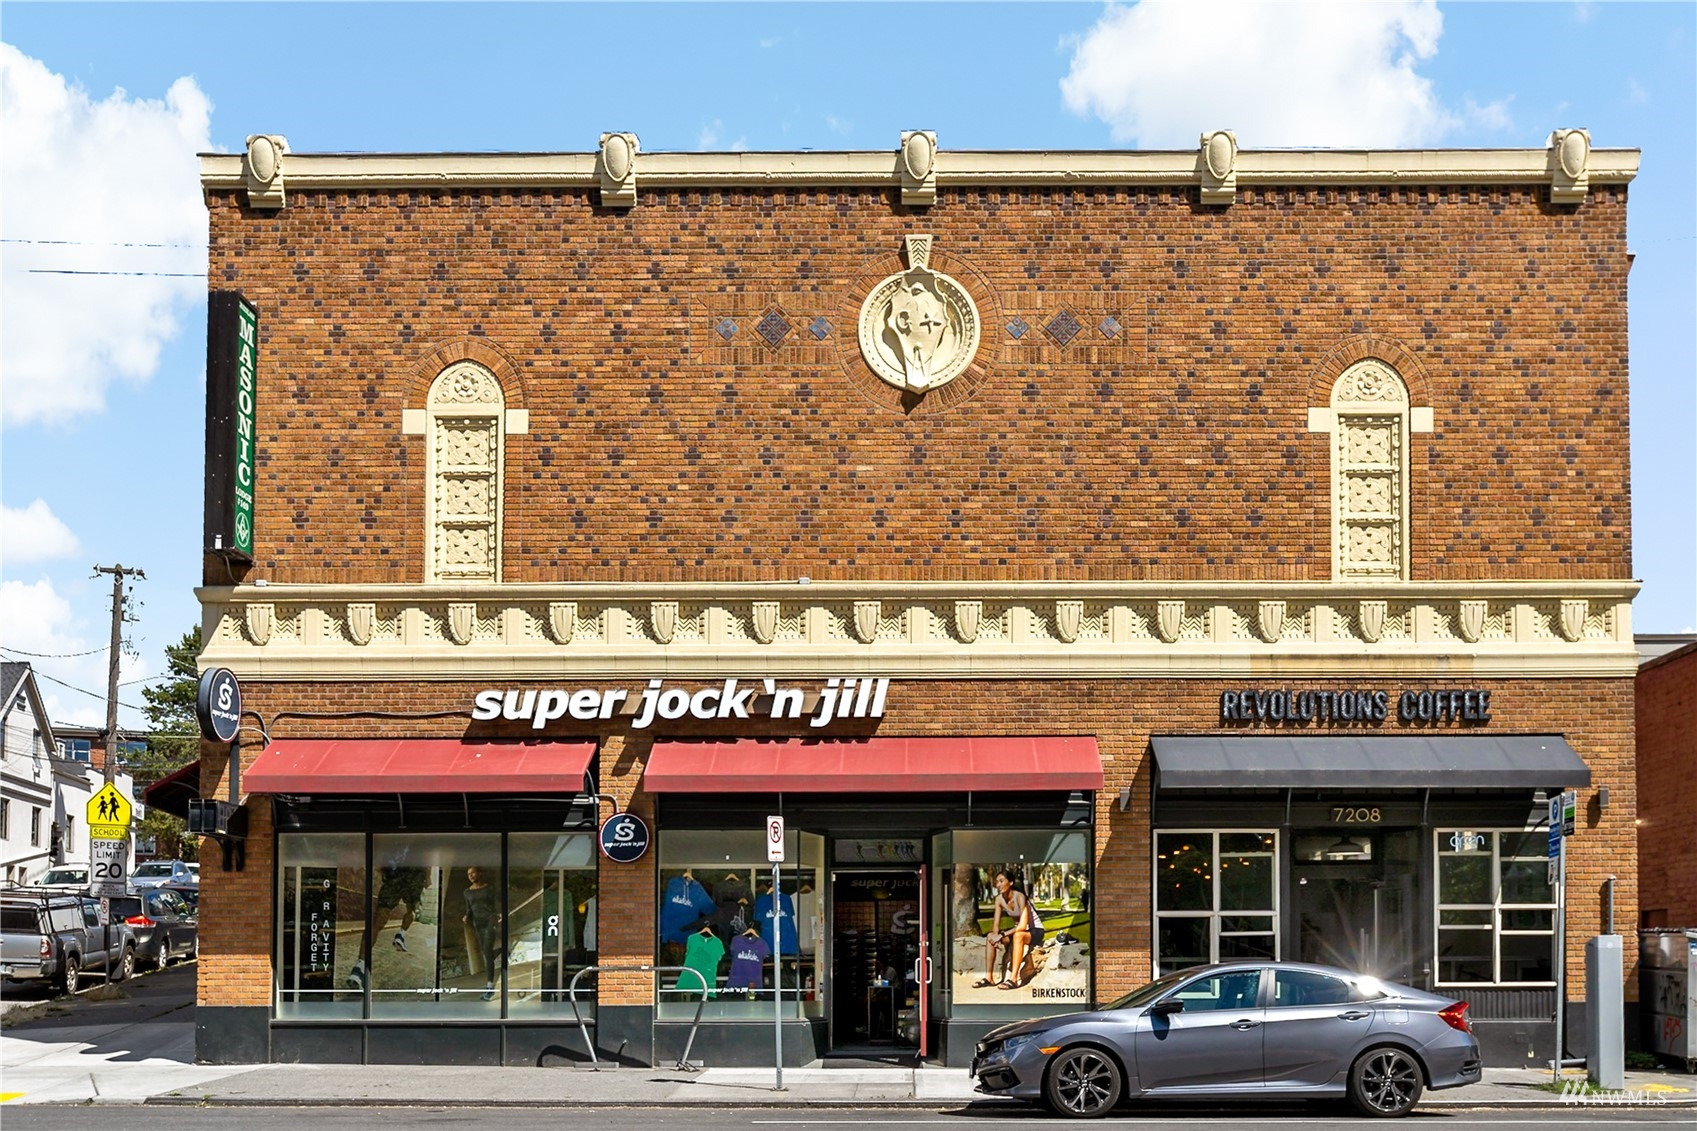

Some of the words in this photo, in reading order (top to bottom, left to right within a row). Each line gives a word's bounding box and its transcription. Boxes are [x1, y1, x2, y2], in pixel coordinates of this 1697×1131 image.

[238, 315, 255, 487] MASONIC
[472, 688, 628, 729] super
[632, 679, 755, 729] jock
[810, 679, 889, 728] jill
[1222, 689, 1388, 721] REVOLUTIONS
[1400, 689, 1492, 721] COFFEE
[1333, 808, 1381, 823] 7208
[93, 828, 125, 837] SCHOOL
[93, 841, 125, 850] SPEED
[96, 851, 121, 859] LIMIT
[95, 862, 122, 879] 20
[850, 879, 889, 889] super
[322, 879, 330, 972] GRAVITY
[310, 912, 318, 972] FORGET
[1032, 988, 1086, 998] BIRKENSTOCK
